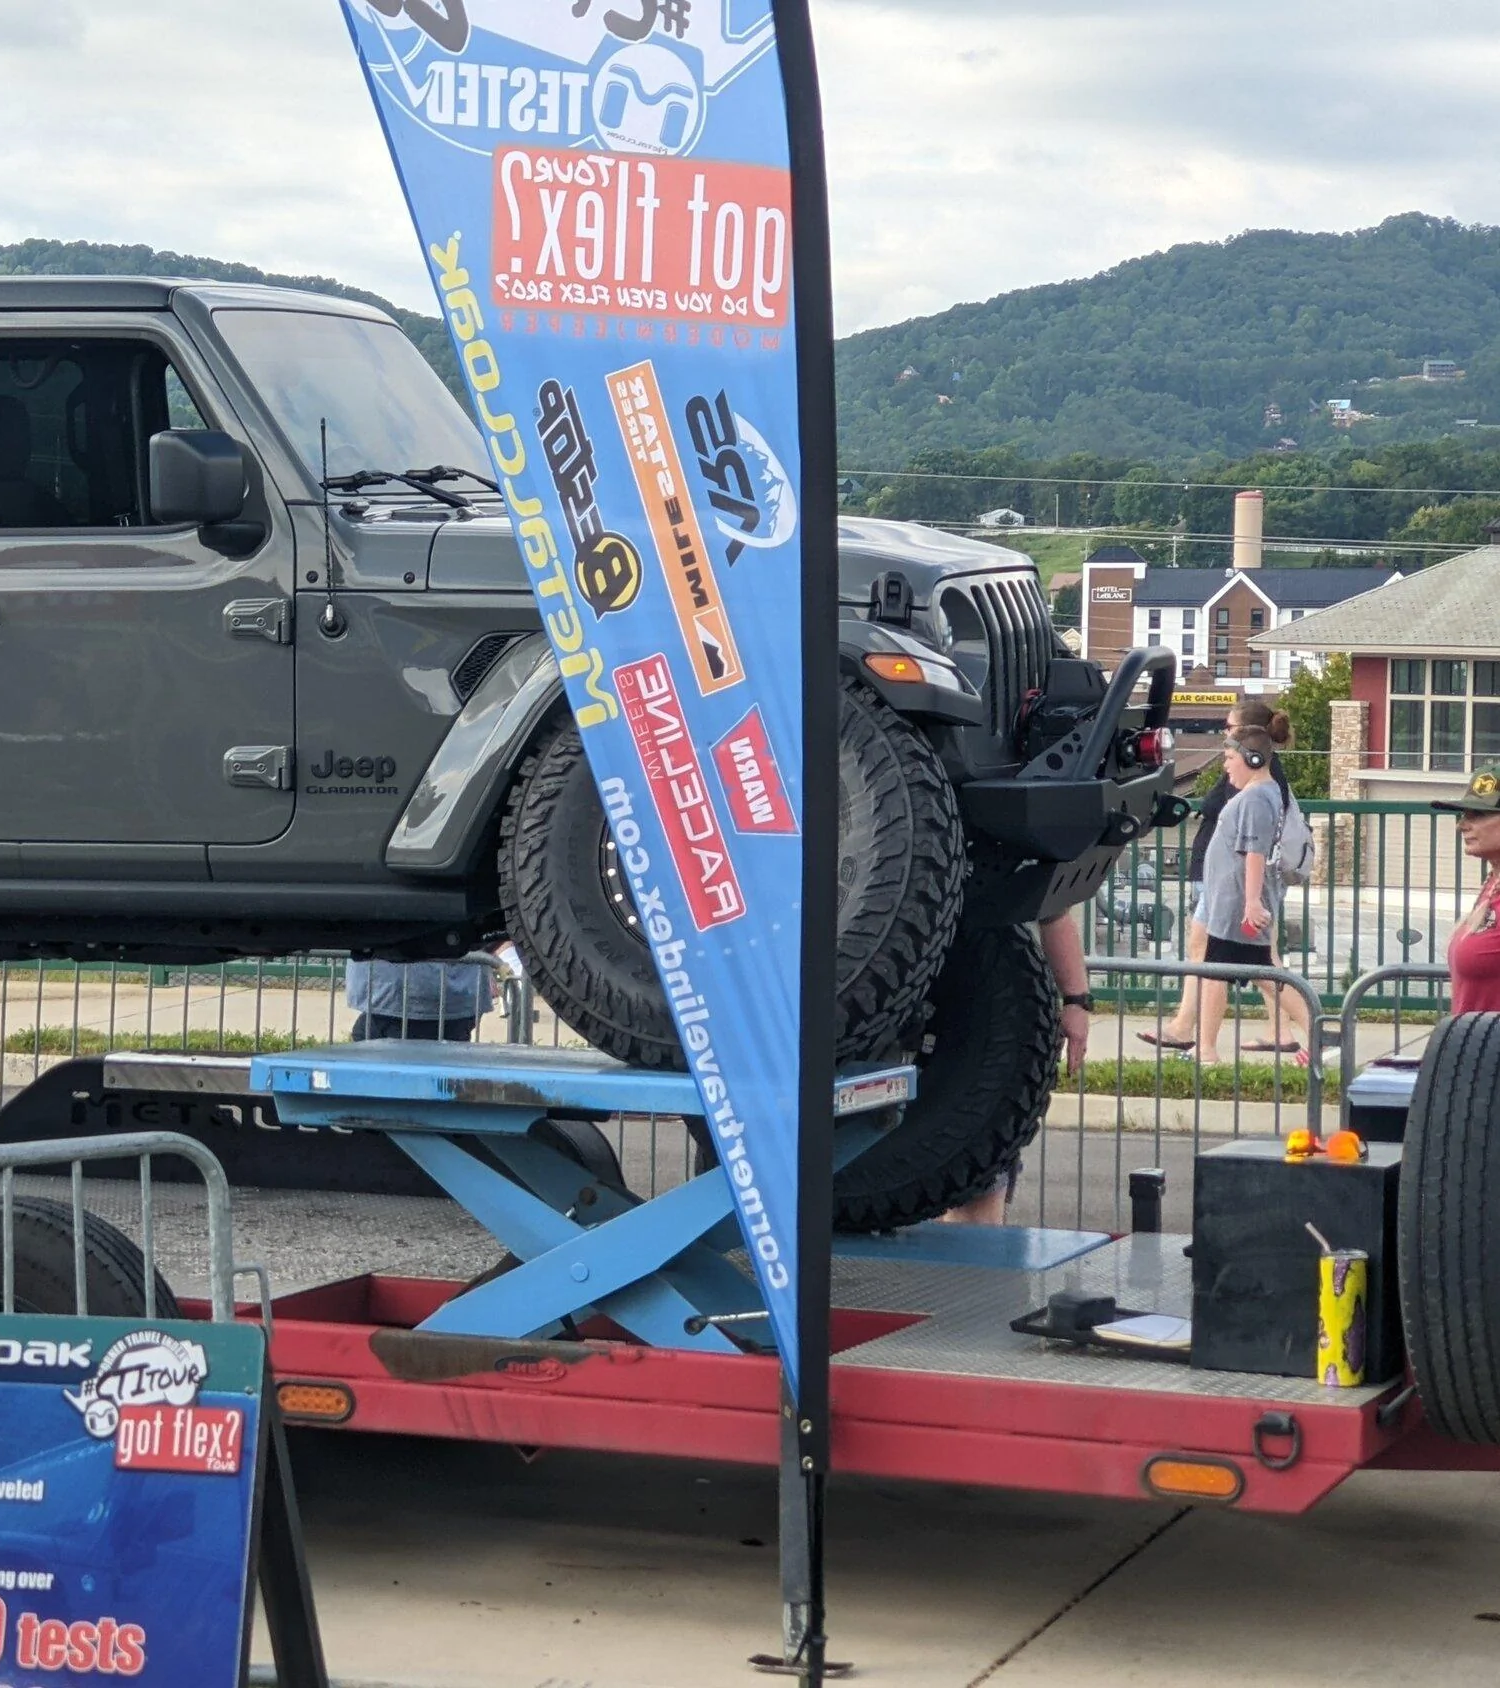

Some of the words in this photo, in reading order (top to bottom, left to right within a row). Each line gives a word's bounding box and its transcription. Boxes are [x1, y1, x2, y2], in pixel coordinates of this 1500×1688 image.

[1172, 694, 1192, 702] LAR
[310, 750, 396, 783] Jeep
[306, 785, 399, 795] GLADIATOR
[125, 1330, 161, 1349] TRAVEL
[117, 1410, 164, 1464] got
[173, 1408, 241, 1459] flex?
[18, 1572, 54, 1590] over
[16, 1611, 146, 1677] tests
